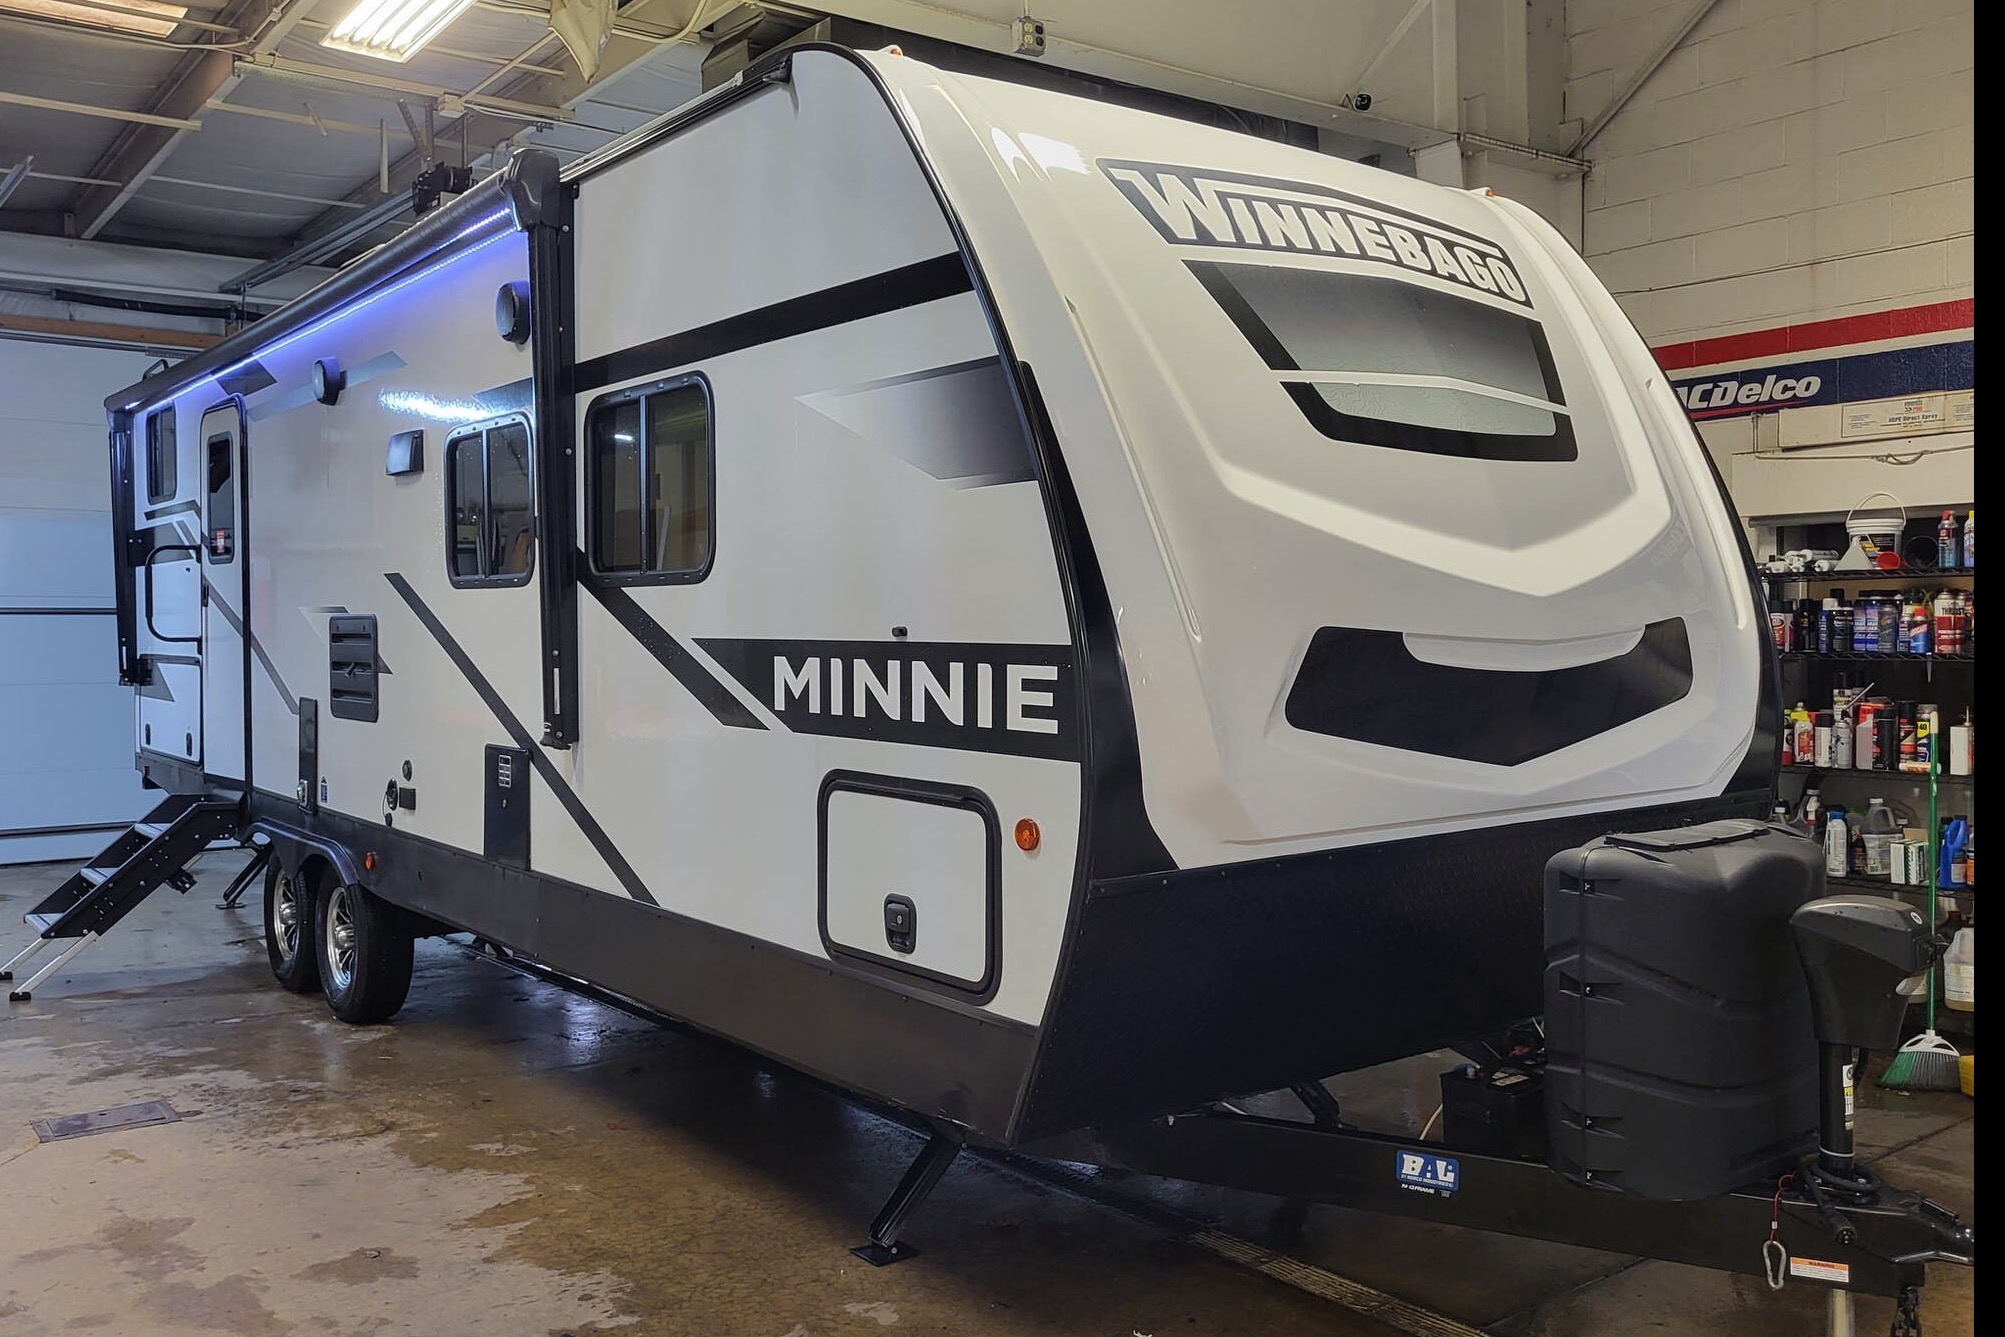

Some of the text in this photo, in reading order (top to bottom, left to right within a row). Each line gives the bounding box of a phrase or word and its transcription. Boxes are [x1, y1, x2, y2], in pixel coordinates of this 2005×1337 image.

[1111, 167, 1527, 302] WINNEBAGO
[773, 655, 1059, 735] MINNIE
[1402, 1154, 1455, 1183] BAL
